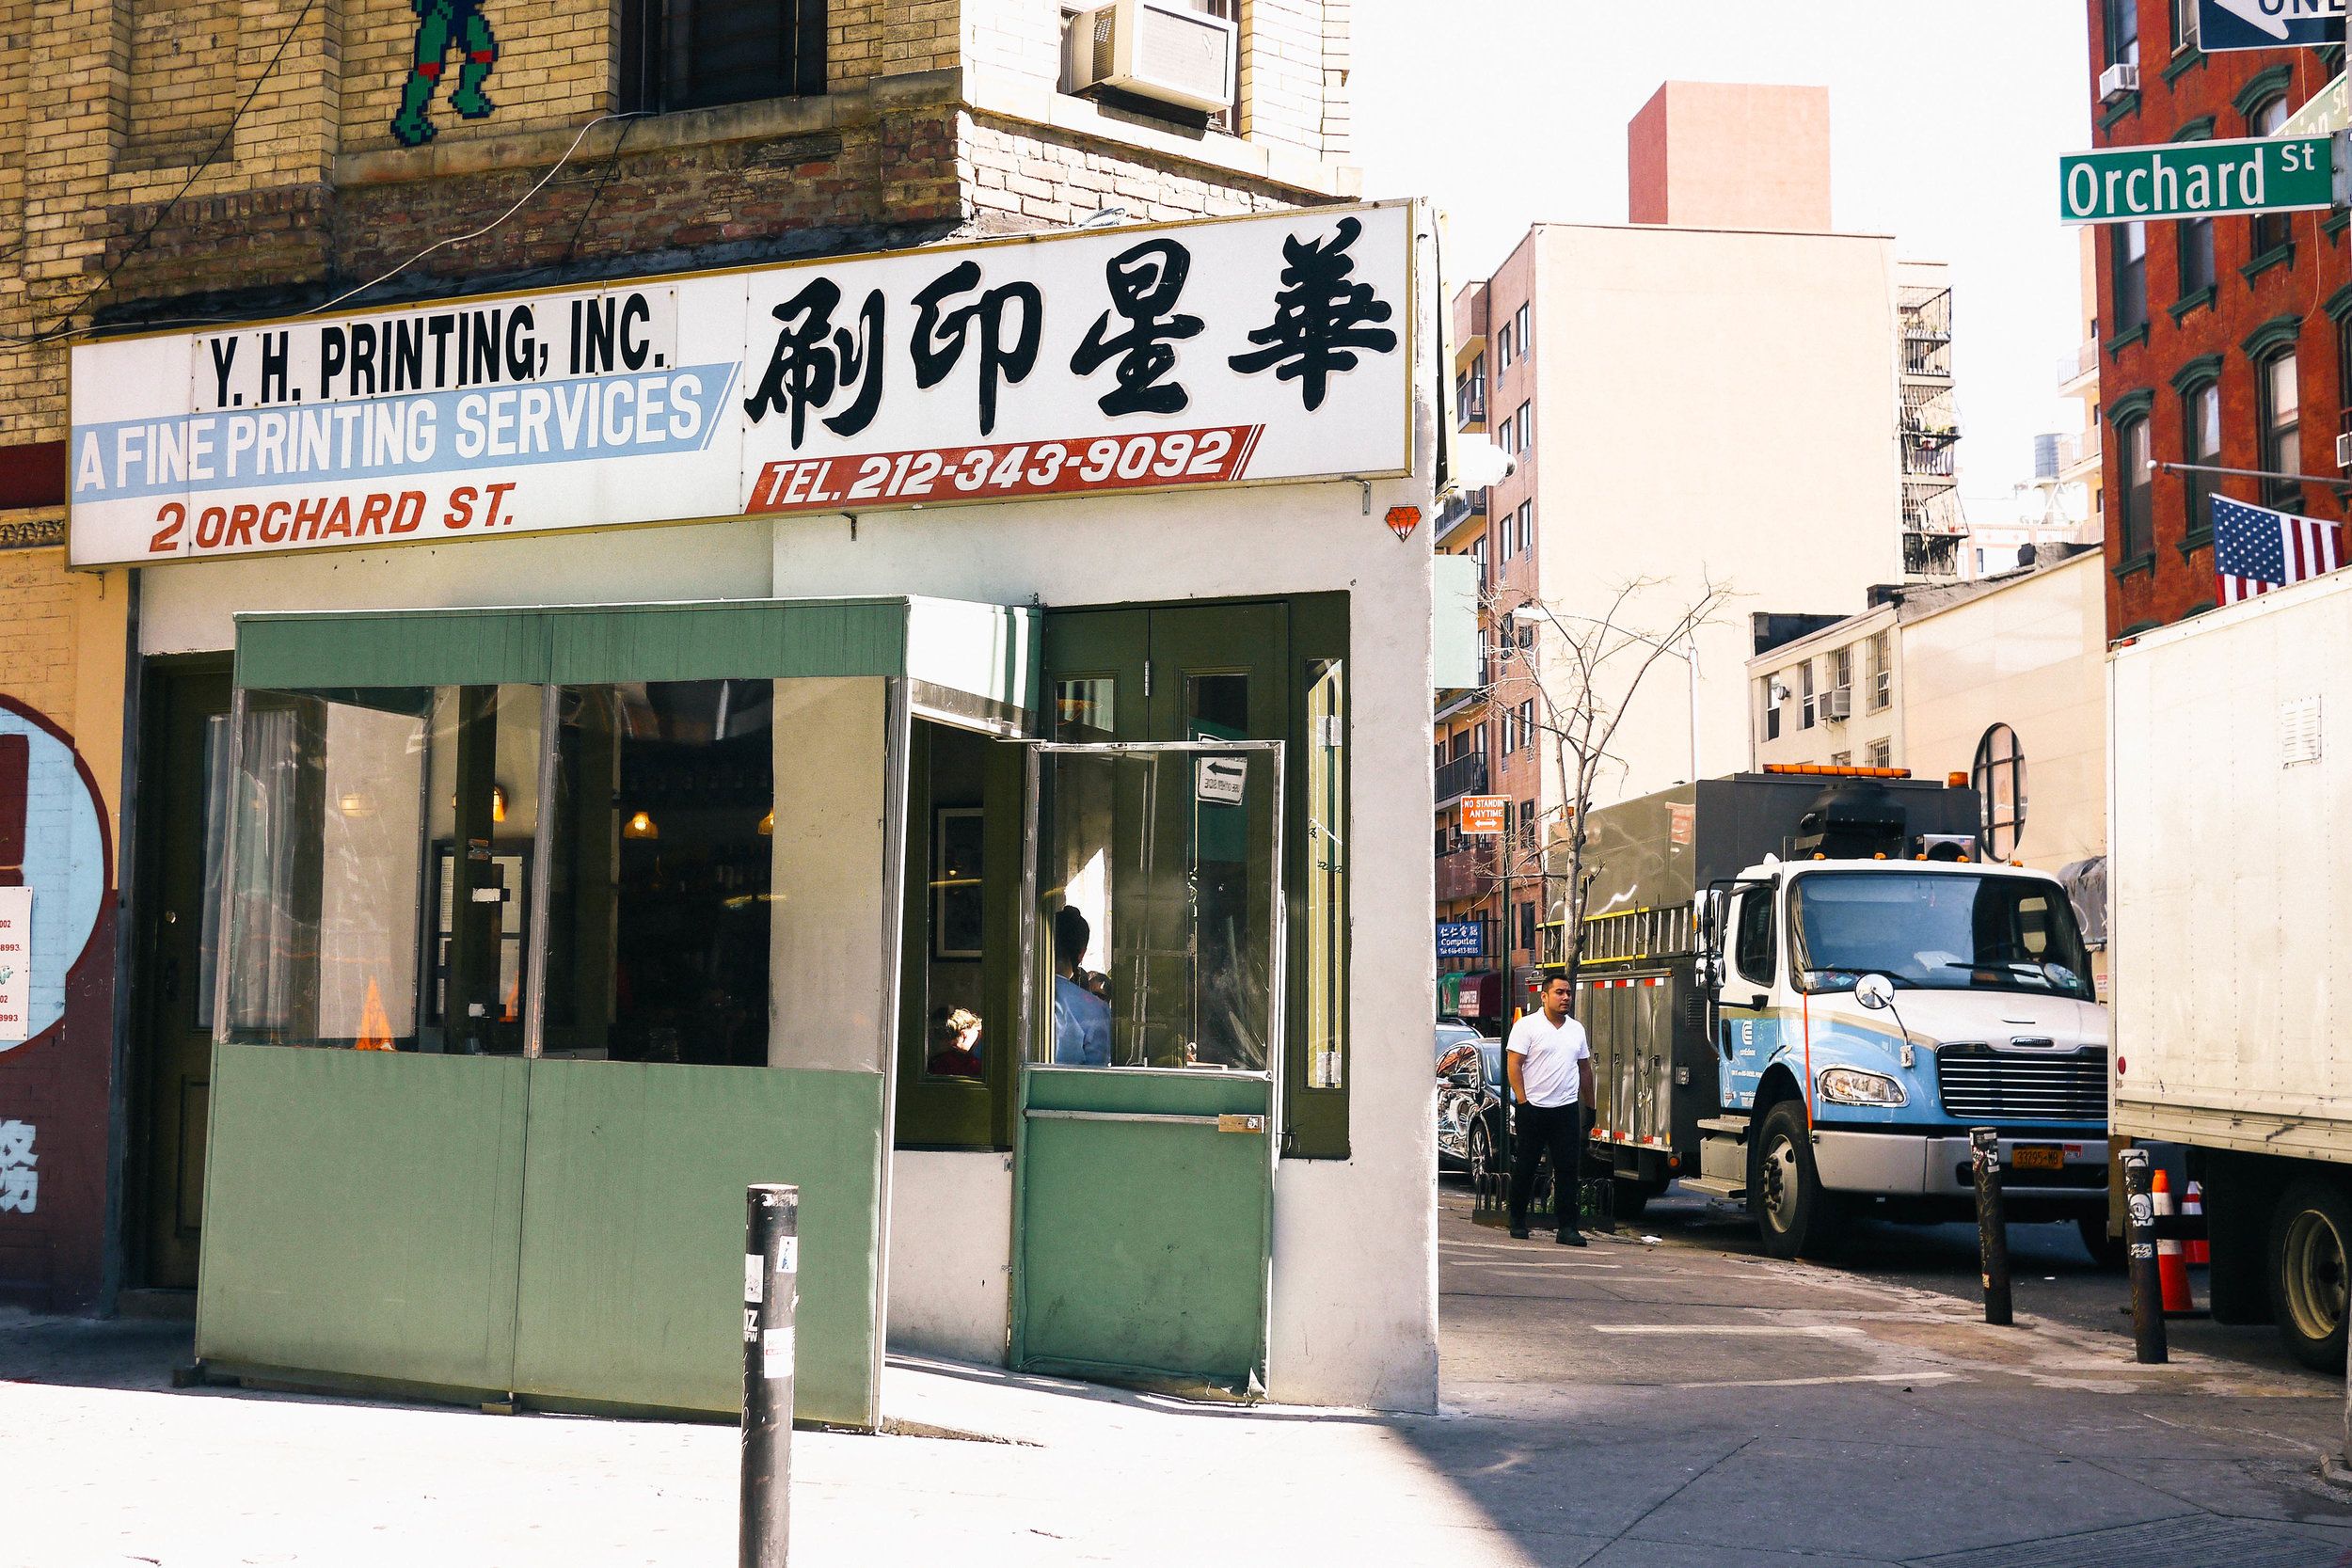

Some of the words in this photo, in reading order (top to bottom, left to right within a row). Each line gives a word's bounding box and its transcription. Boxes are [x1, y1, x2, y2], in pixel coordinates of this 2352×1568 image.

[2067, 147, 2265, 216] Orchard
[2280, 142, 2315, 172] St
[210, 336, 243, 408] Y.
[261, 330, 301, 404] H.
[320, 305, 548, 400] PRINTING,
[570, 293, 664, 375] INC.
[76, 431, 106, 493] A
[117, 418, 215, 488] FINE
[227, 398, 437, 478] PRINTING
[455, 373, 703, 459] SERVICES
[766, 460, 841, 505] TEL.
[847, 430, 1232, 499] 212-343-9092
[150, 502, 186, 552] 2
[196, 490, 427, 548] ORCHARD
[443, 482, 516, 530] ST.
[1464, 800, 1474, 808] NO
[1476, 799, 1506, 808] STANDIN
[1470, 809, 1503, 818] ANYTIME
[1440, 937, 1477, 947] Computer
